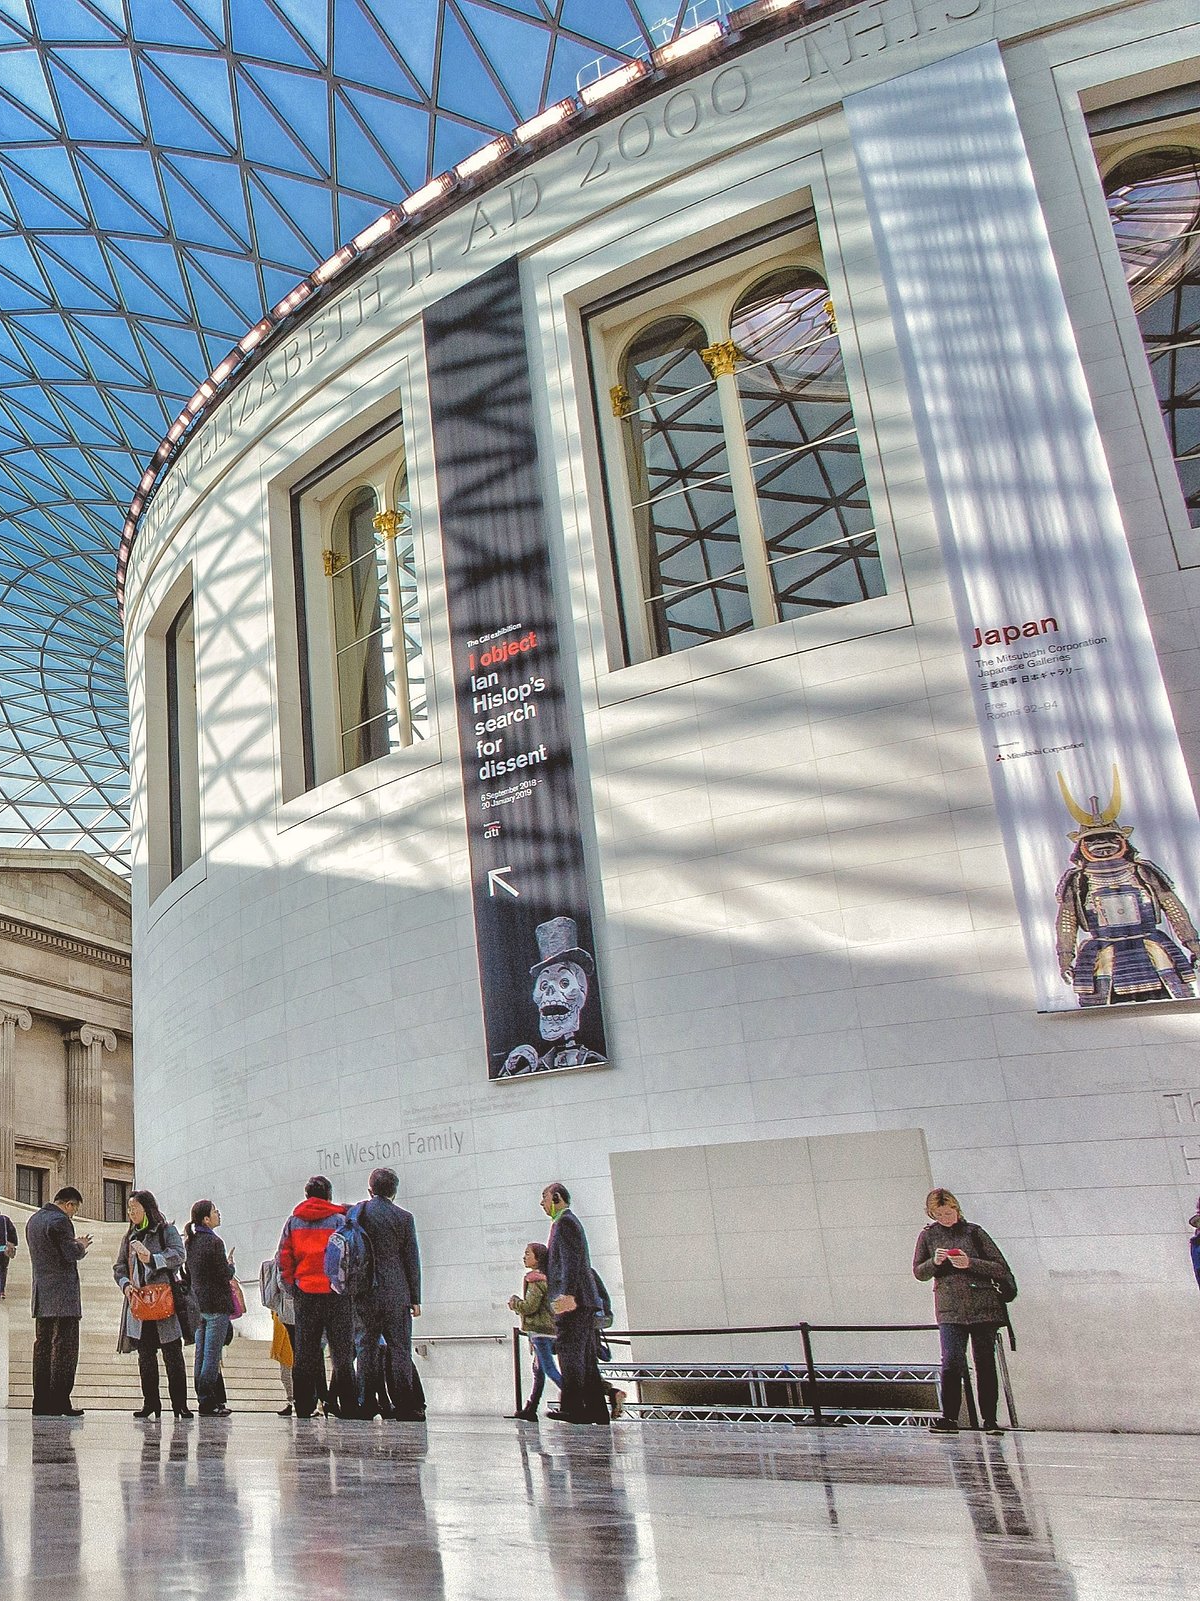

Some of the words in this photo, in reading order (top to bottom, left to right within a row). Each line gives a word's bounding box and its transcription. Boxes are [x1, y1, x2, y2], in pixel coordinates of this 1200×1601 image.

[197, 265, 389, 472] ELIZABETH
[461, 173, 543, 256] AD
[576, 65, 752, 189] 2000
[466, 639, 479, 648] The
[491, 624, 521, 638] exhibition
[973, 617, 1059, 648] Japan
[470, 654, 475, 670] I
[481, 632, 537, 666] object
[976, 659, 993, 668] The
[996, 649, 1046, 663] Mitsubishi
[1049, 636, 1107, 653] Corporation
[978, 663, 1025, 678] Japanese
[1027, 654, 1071, 668] Galleries
[472, 671, 498, 692] Ian
[473, 677, 545, 714] Hislop's
[985, 700, 1006, 711] Free
[475, 703, 536, 736] search
[987, 708, 1021, 721] Rooms
[477, 737, 503, 759] for
[1007, 750, 1041, 761] Mitsubishi
[1043, 742, 1085, 754] Corporation
[480, 744, 547, 780] dissent
[481, 801, 490, 810] 20
[490, 795, 516, 807] January
[515, 788, 532, 799] 2019
[485, 785, 519, 800] September
[519, 779, 537, 790] 2018
[316, 1149, 341, 1172] The
[343, 1137, 402, 1166] Weston
[406, 1125, 465, 1157] Family
